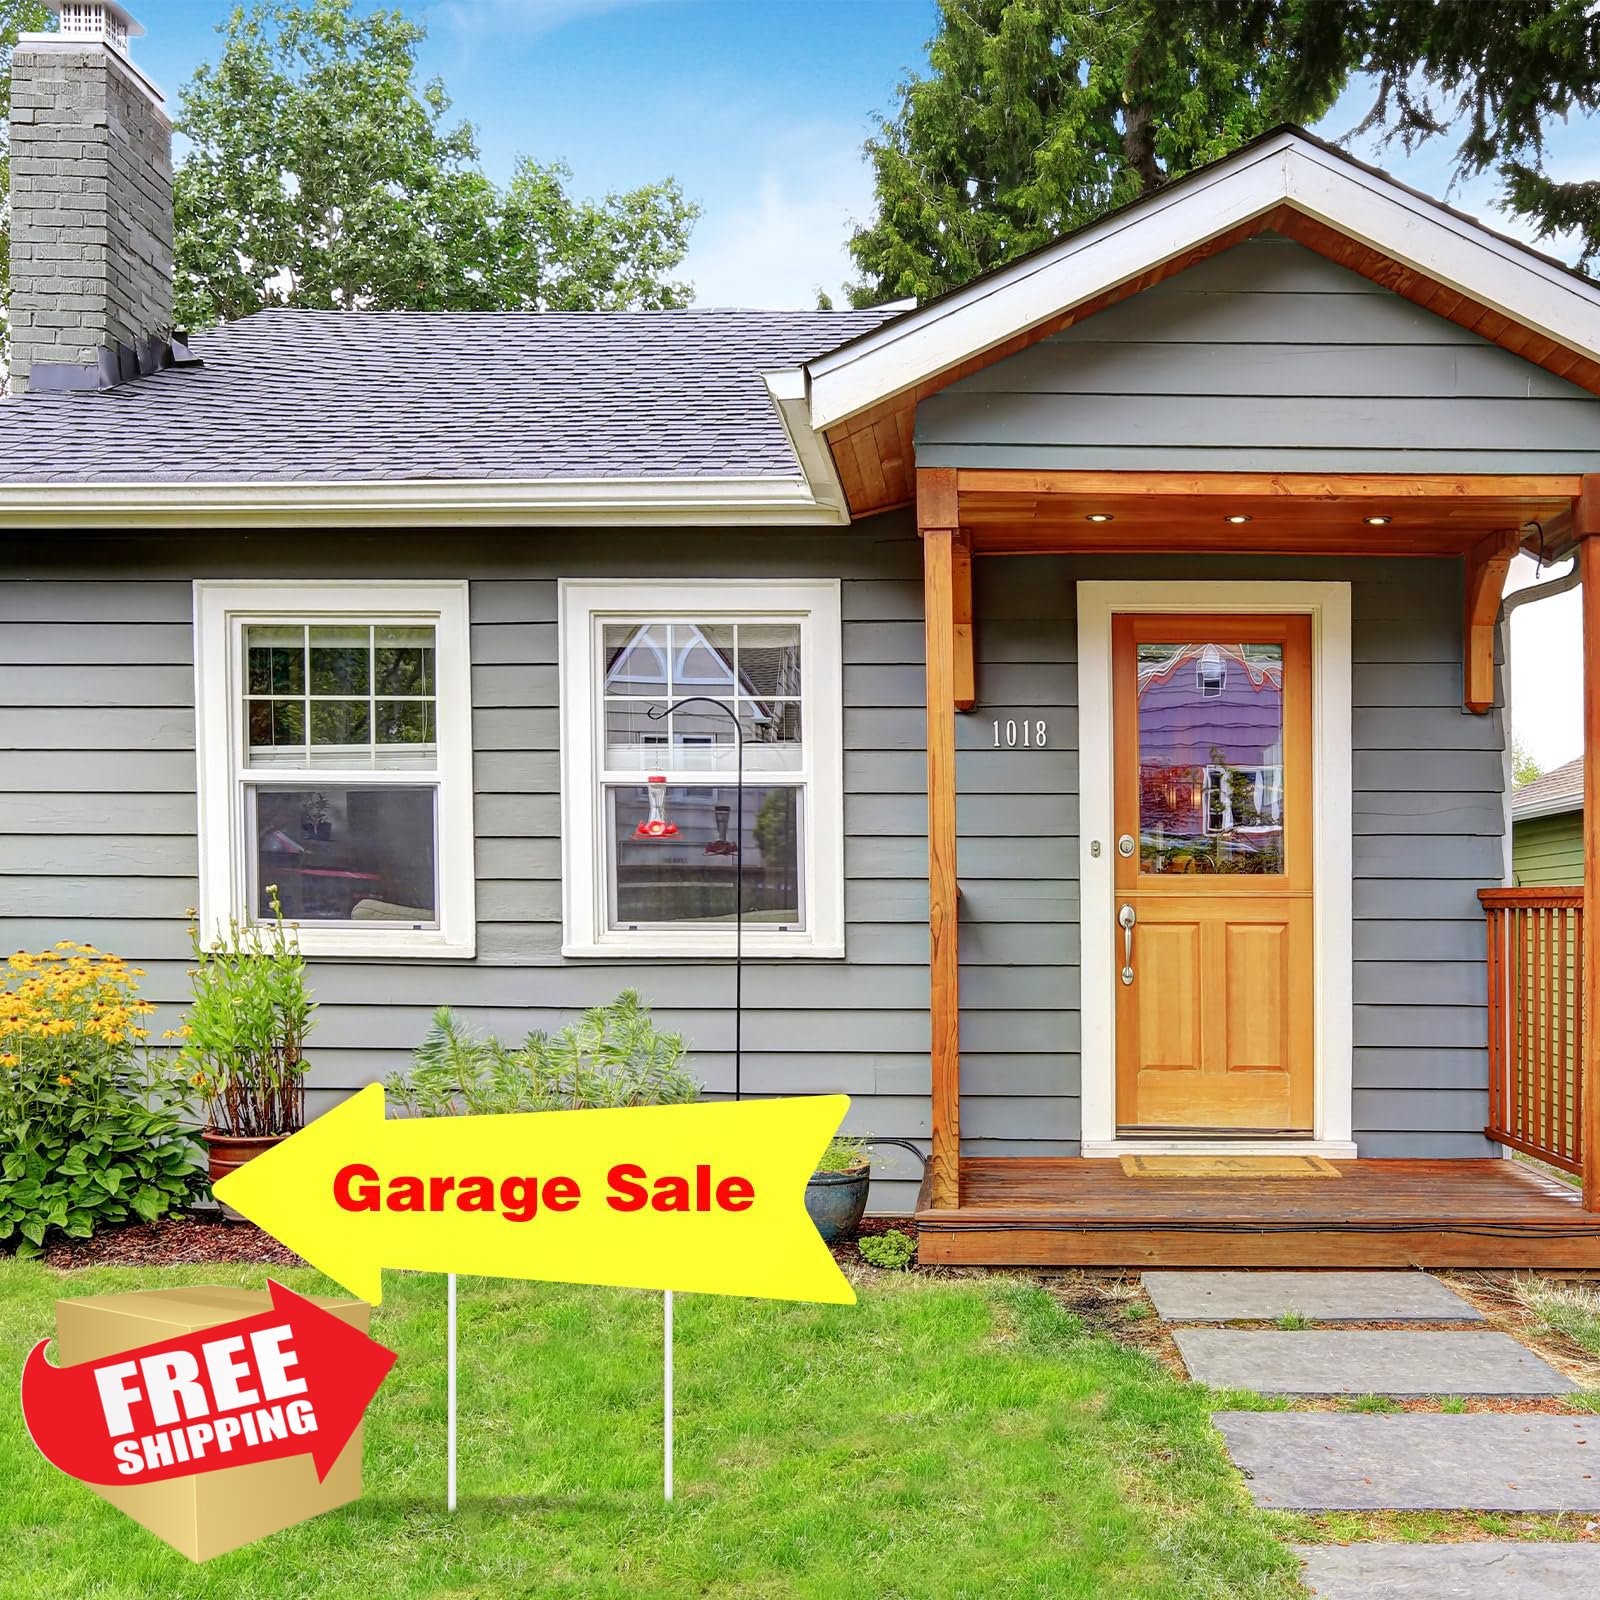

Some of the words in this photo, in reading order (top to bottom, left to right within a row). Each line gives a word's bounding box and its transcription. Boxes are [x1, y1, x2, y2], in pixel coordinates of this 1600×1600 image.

[993, 719, 1047, 748] 1018
[333, 1163, 581, 1223] Garage
[606, 1163, 755, 1213] Sale
